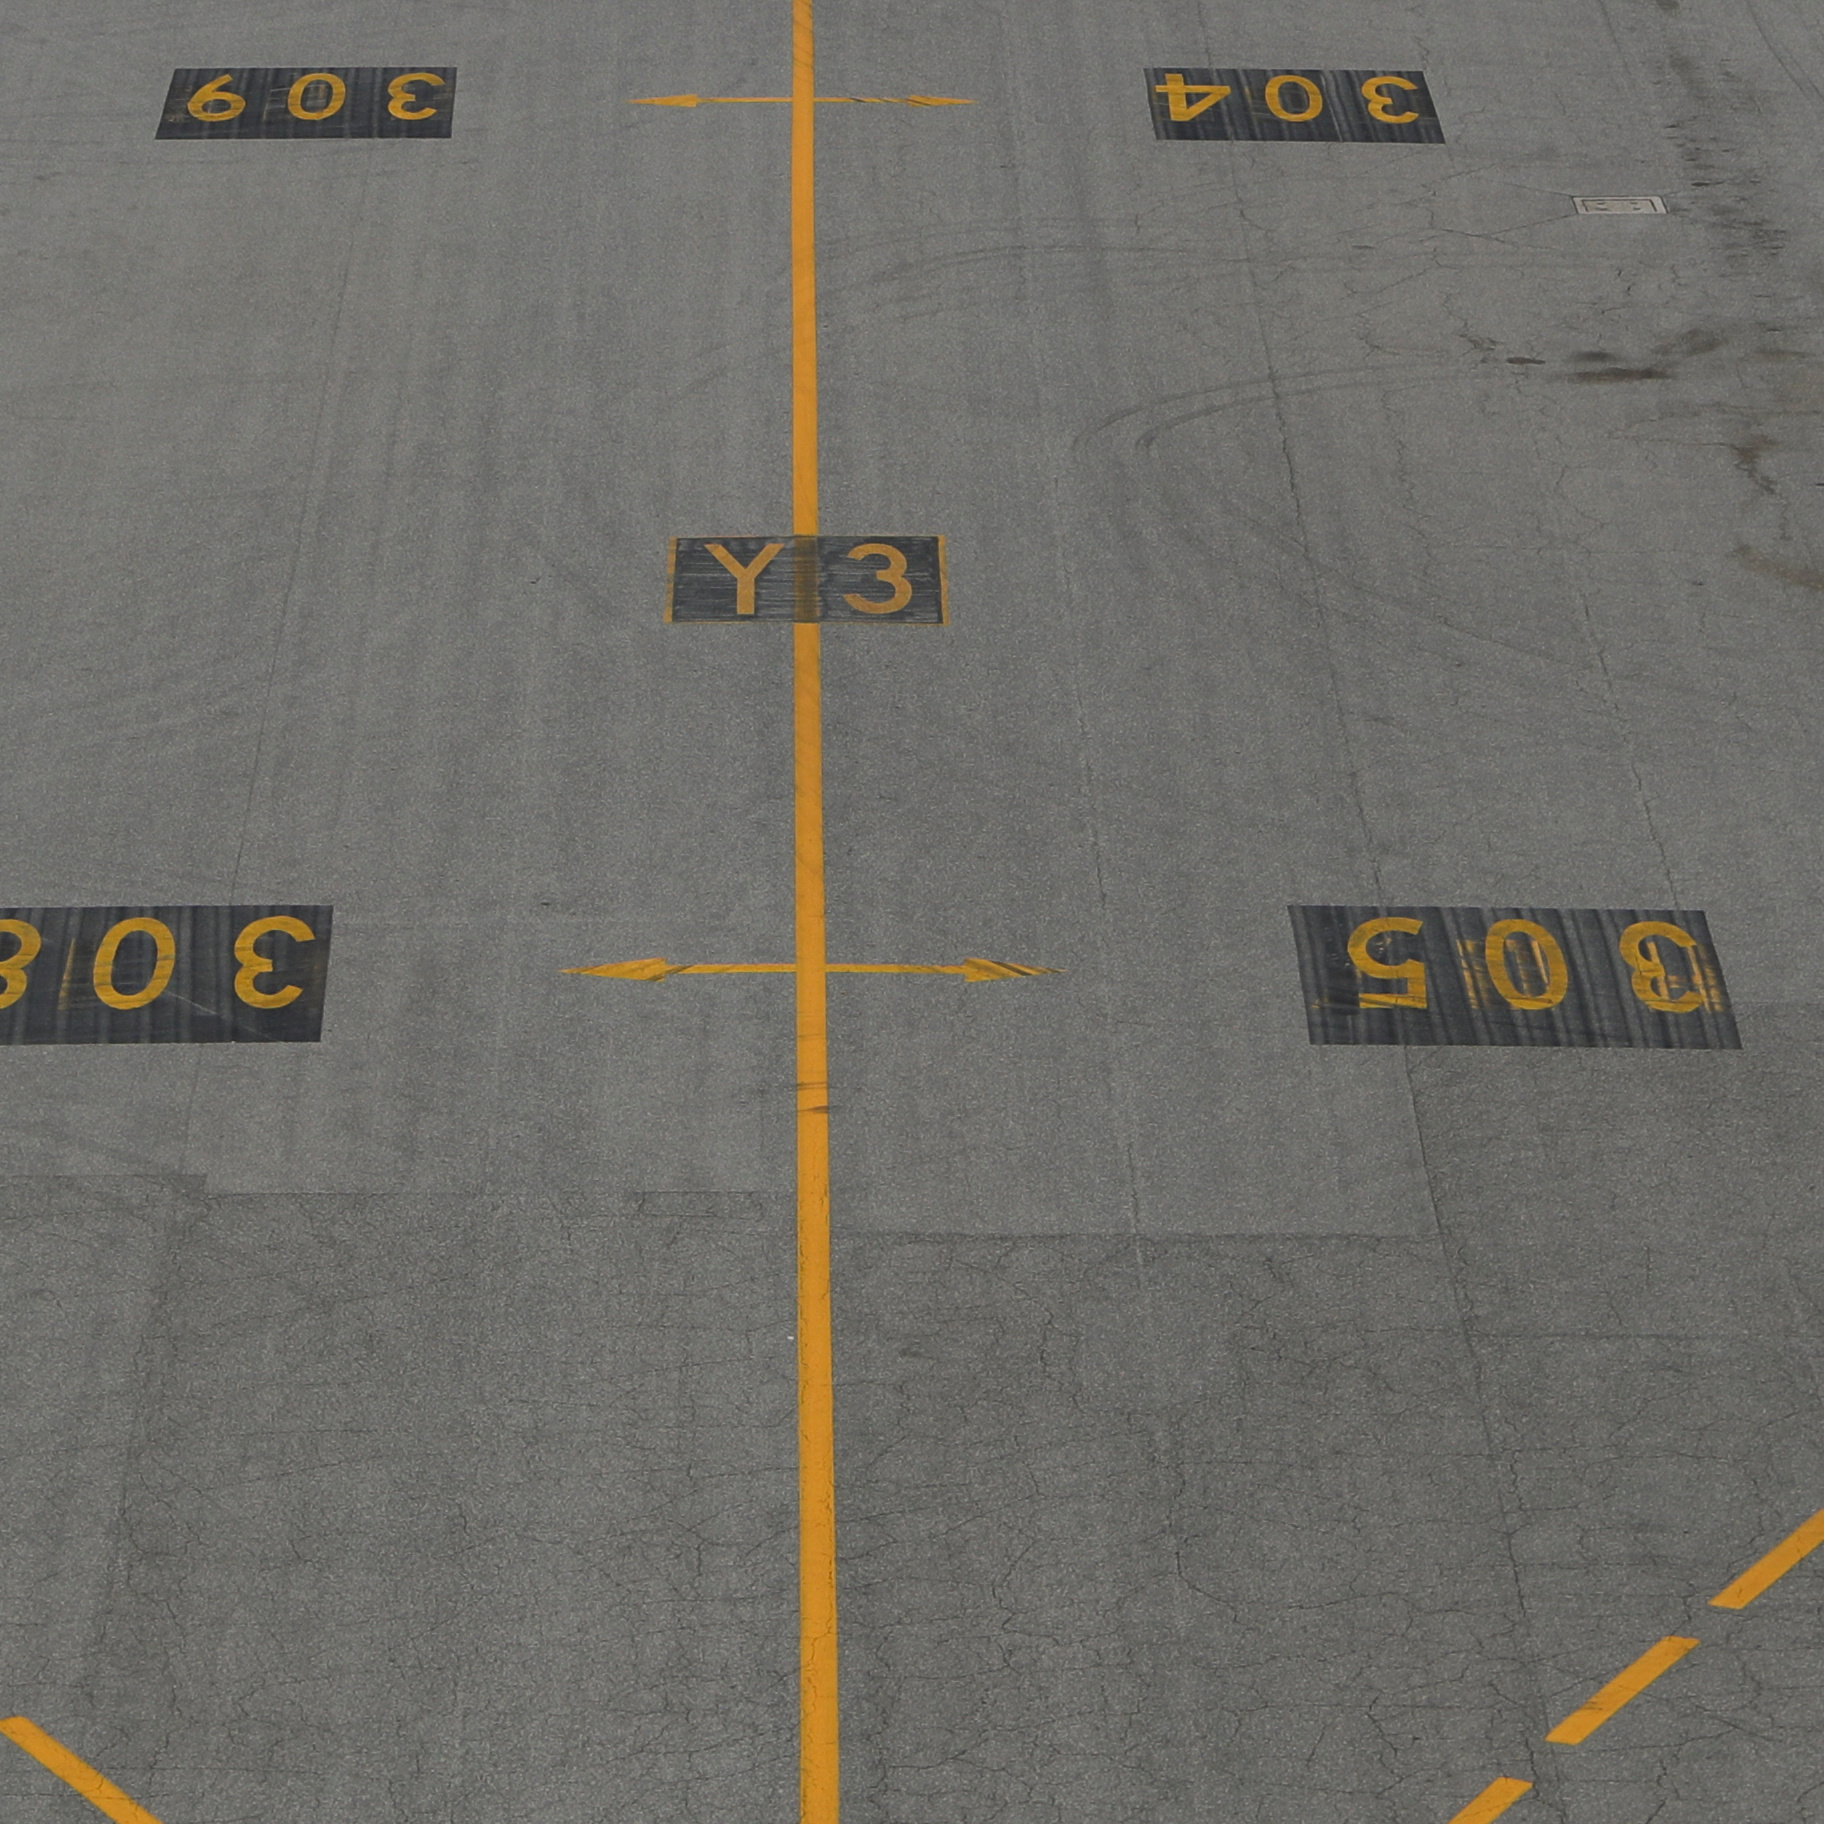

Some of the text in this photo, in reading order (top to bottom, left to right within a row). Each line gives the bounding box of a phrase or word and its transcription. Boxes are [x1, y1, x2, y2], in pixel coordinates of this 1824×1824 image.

[186, 72, 448, 124] 309
[1153, 72, 1422, 126] 304
[1345, 914, 1710, 1016] 305
